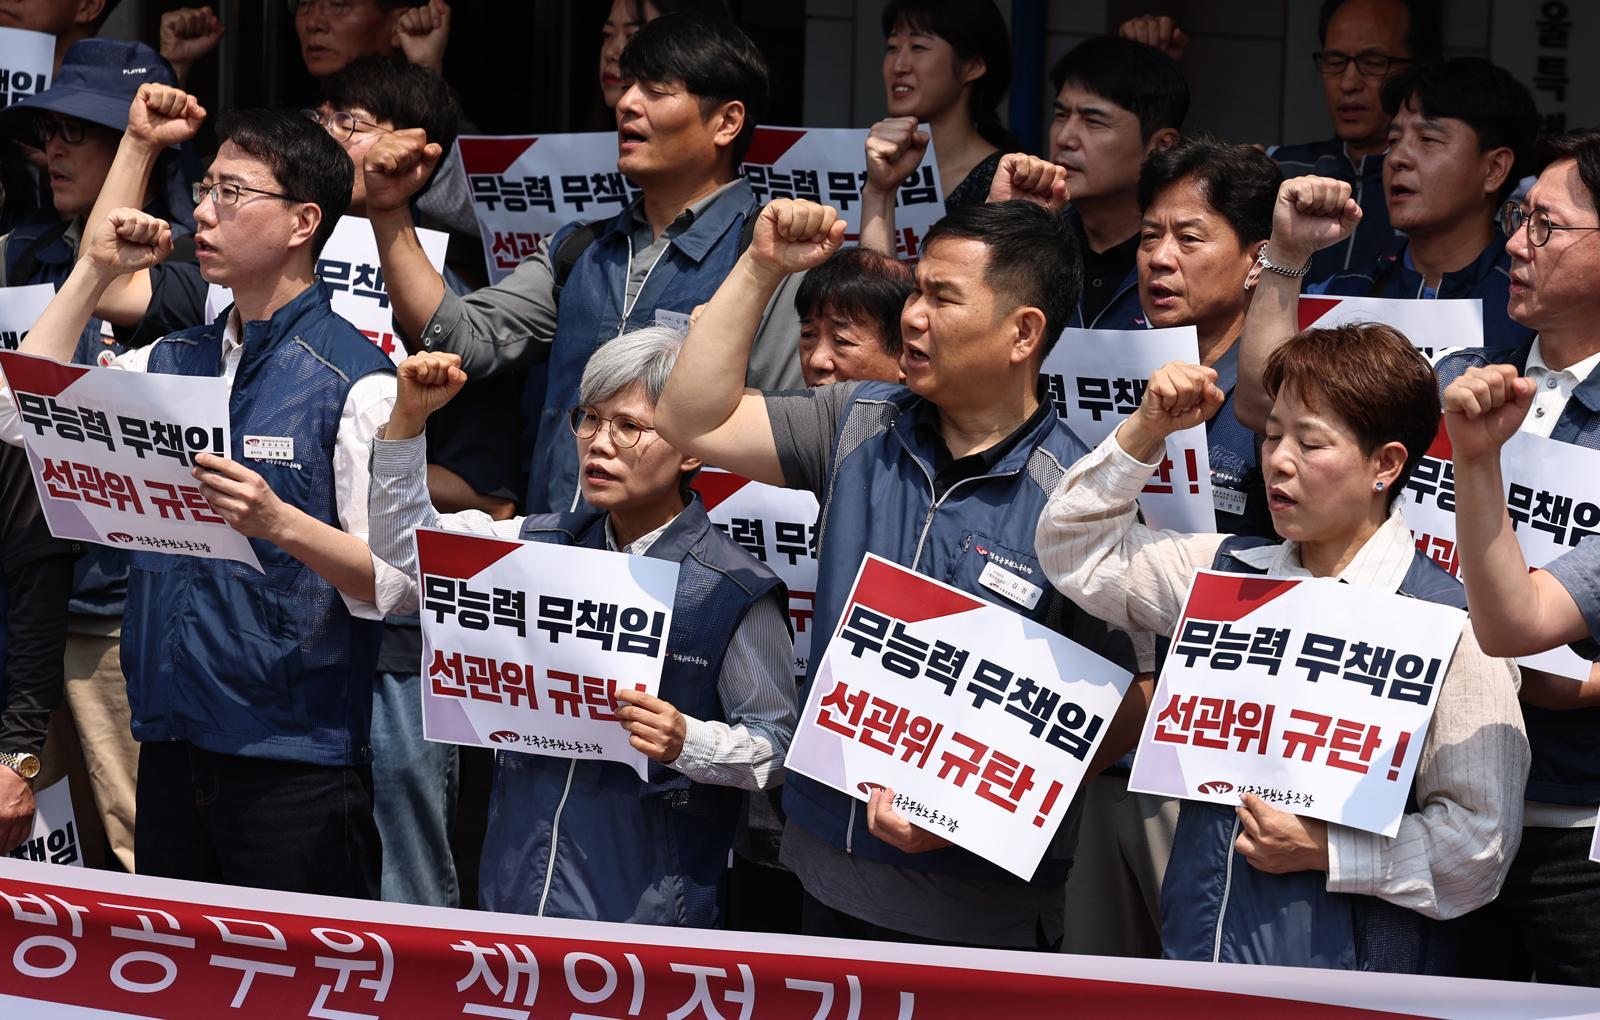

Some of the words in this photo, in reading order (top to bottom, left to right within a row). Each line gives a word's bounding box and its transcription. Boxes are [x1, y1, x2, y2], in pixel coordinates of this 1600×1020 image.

[123, 67, 147, 75] PLAYER
[470, 173, 556, 213] 무능력
[561, 172, 643, 212] 무책
[827, 165, 938, 211] 무임
[16, 392, 116, 453] 무능력
[117, 415, 225, 468] 무책임
[43, 457, 146, 515] 선관위
[425, 575, 527, 638] 무능력
[537, 594, 666, 659] 무책임
[429, 649, 539, 711] 선관위
[546, 669, 624, 723] 규탄
[841, 605, 970, 697] 무능력
[966, 658, 1105, 762] 무책임
[1174, 620, 1292, 677] 무능력
[1295, 632, 1442, 706] 무책임
[816, 680, 945, 769] 선관위
[936, 731, 1036, 814] 규탄
[1153, 693, 1276, 756] 선관위
[1281, 708, 1382, 775] 규탄
[891, 793, 960, 834] 국공무원노동조합
[0, 890, 395, 1020] 방공무원
